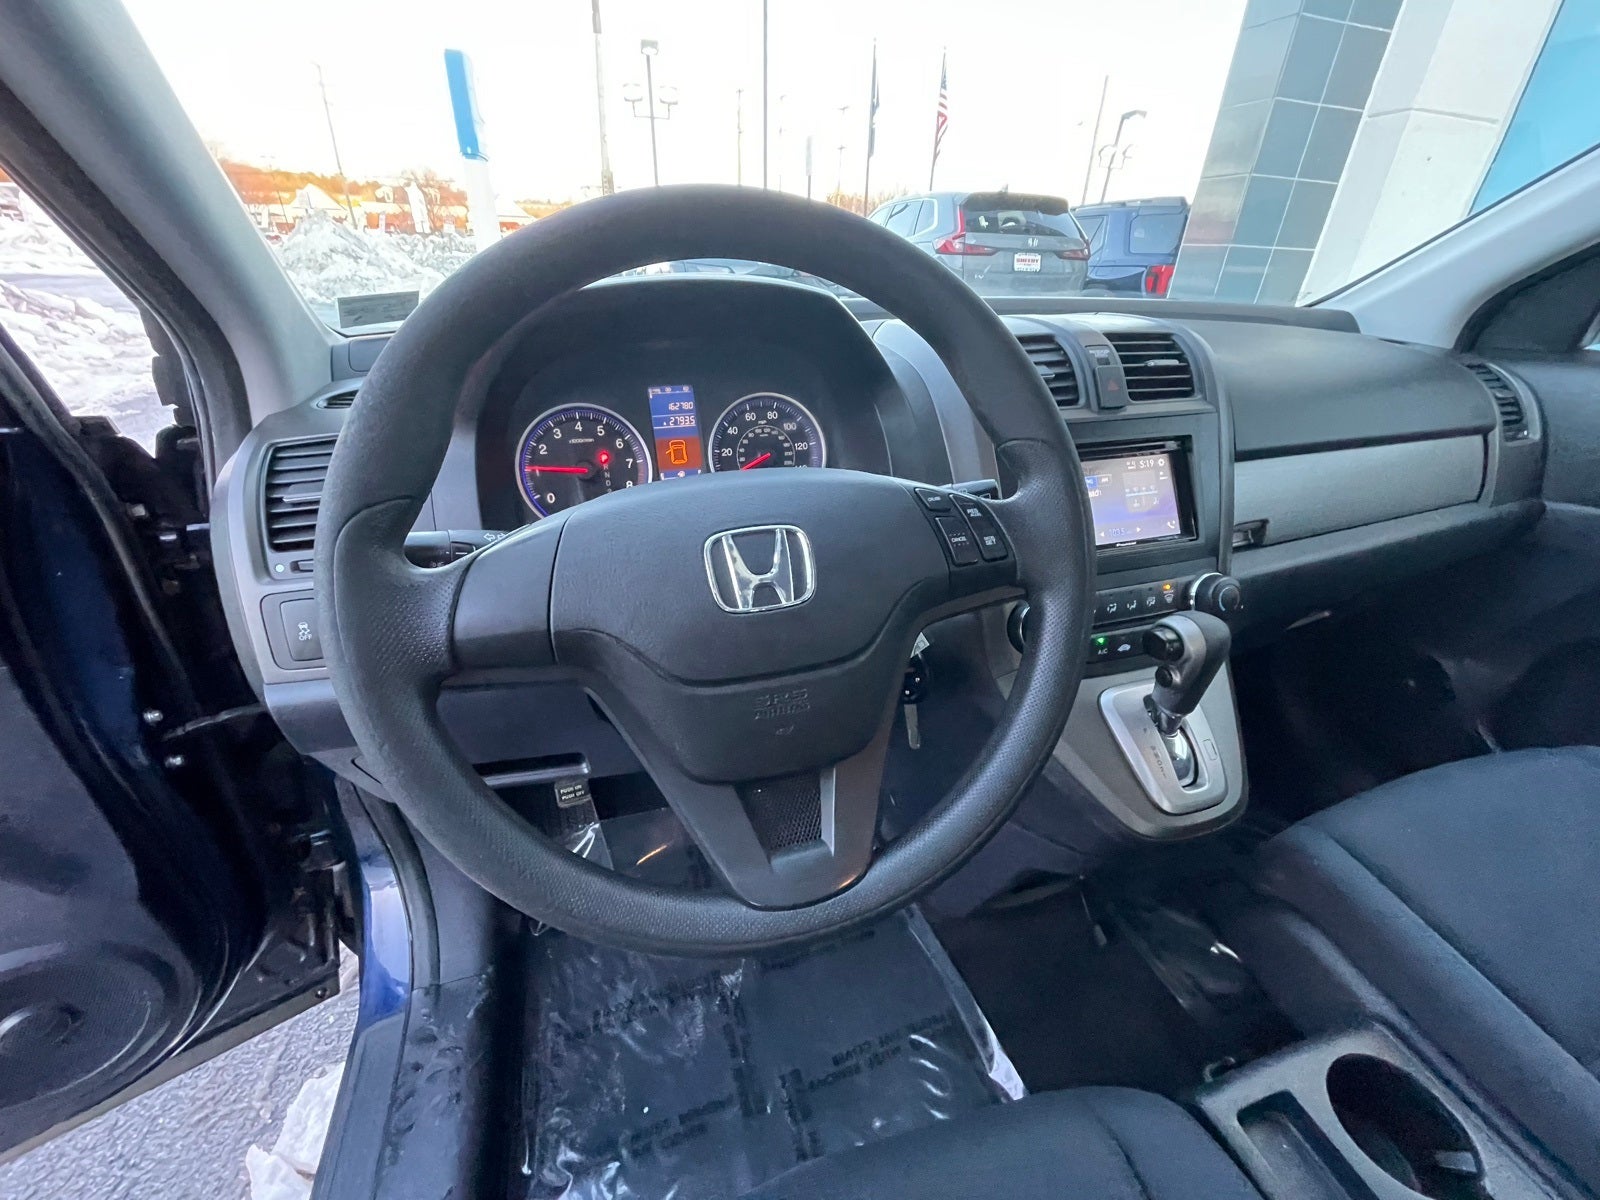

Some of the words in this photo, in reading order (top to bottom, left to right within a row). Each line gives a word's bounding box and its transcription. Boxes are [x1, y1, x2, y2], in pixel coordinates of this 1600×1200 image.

[745, 412, 756, 421] 60
[767, 411, 778, 420] 80
[574, 421, 583, 432] 4
[597, 425, 605, 436] 5
[727, 426, 738, 435] 40
[783, 422, 797, 431] 100
[553, 428, 562, 439] 3
[615, 438, 624, 449] 6
[794, 442, 808, 450] 120
[538, 444, 548, 455] 2
[721, 447, 733, 457] 20
[625, 458, 634, 469] 7
[1139, 459, 1154, 469] 5:19
[546, 492, 556, 504] 0
[298, 633, 313, 641] OFF
